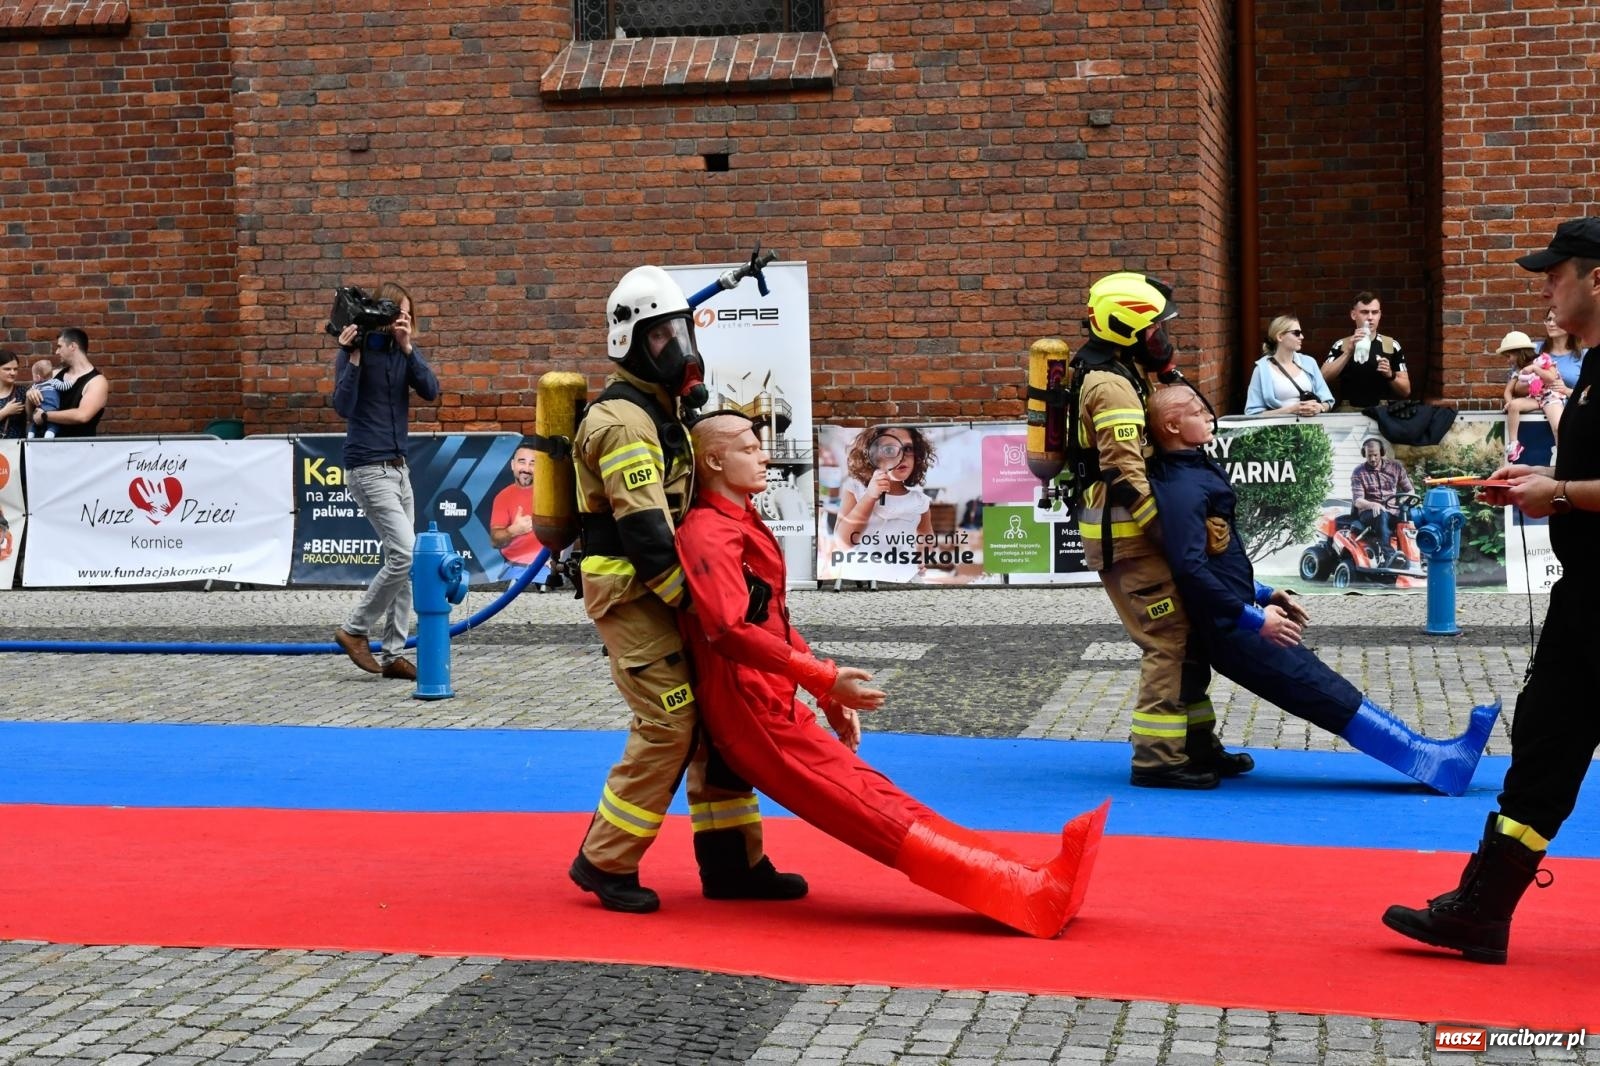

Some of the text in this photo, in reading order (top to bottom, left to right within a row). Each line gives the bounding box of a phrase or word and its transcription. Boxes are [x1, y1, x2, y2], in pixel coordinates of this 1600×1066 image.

[717, 308, 779, 321] GAZ
[1117, 427, 1135, 439] OSP
[127, 452, 188, 475] Fundacja
[629, 468, 653, 485] OSP
[306, 487, 356, 502] na zak
[81, 498, 238, 527] Nasze Dzieci
[312, 505, 367, 521] paliwa z
[131, 536, 184, 549] Kornice
[303, 539, 383, 554] #BENEFITY
[850, 530, 969, 548] Coś więcej niż
[302, 553, 381, 565] PRACOWNICZE
[831, 547, 974, 566] przedszkole
[1526, 548, 1553, 557] AUTOR
[77, 563, 232, 580] www.fundacjakornice.pl
[1151, 602, 1170, 617] OSP
[666, 688, 688, 708] OSP
